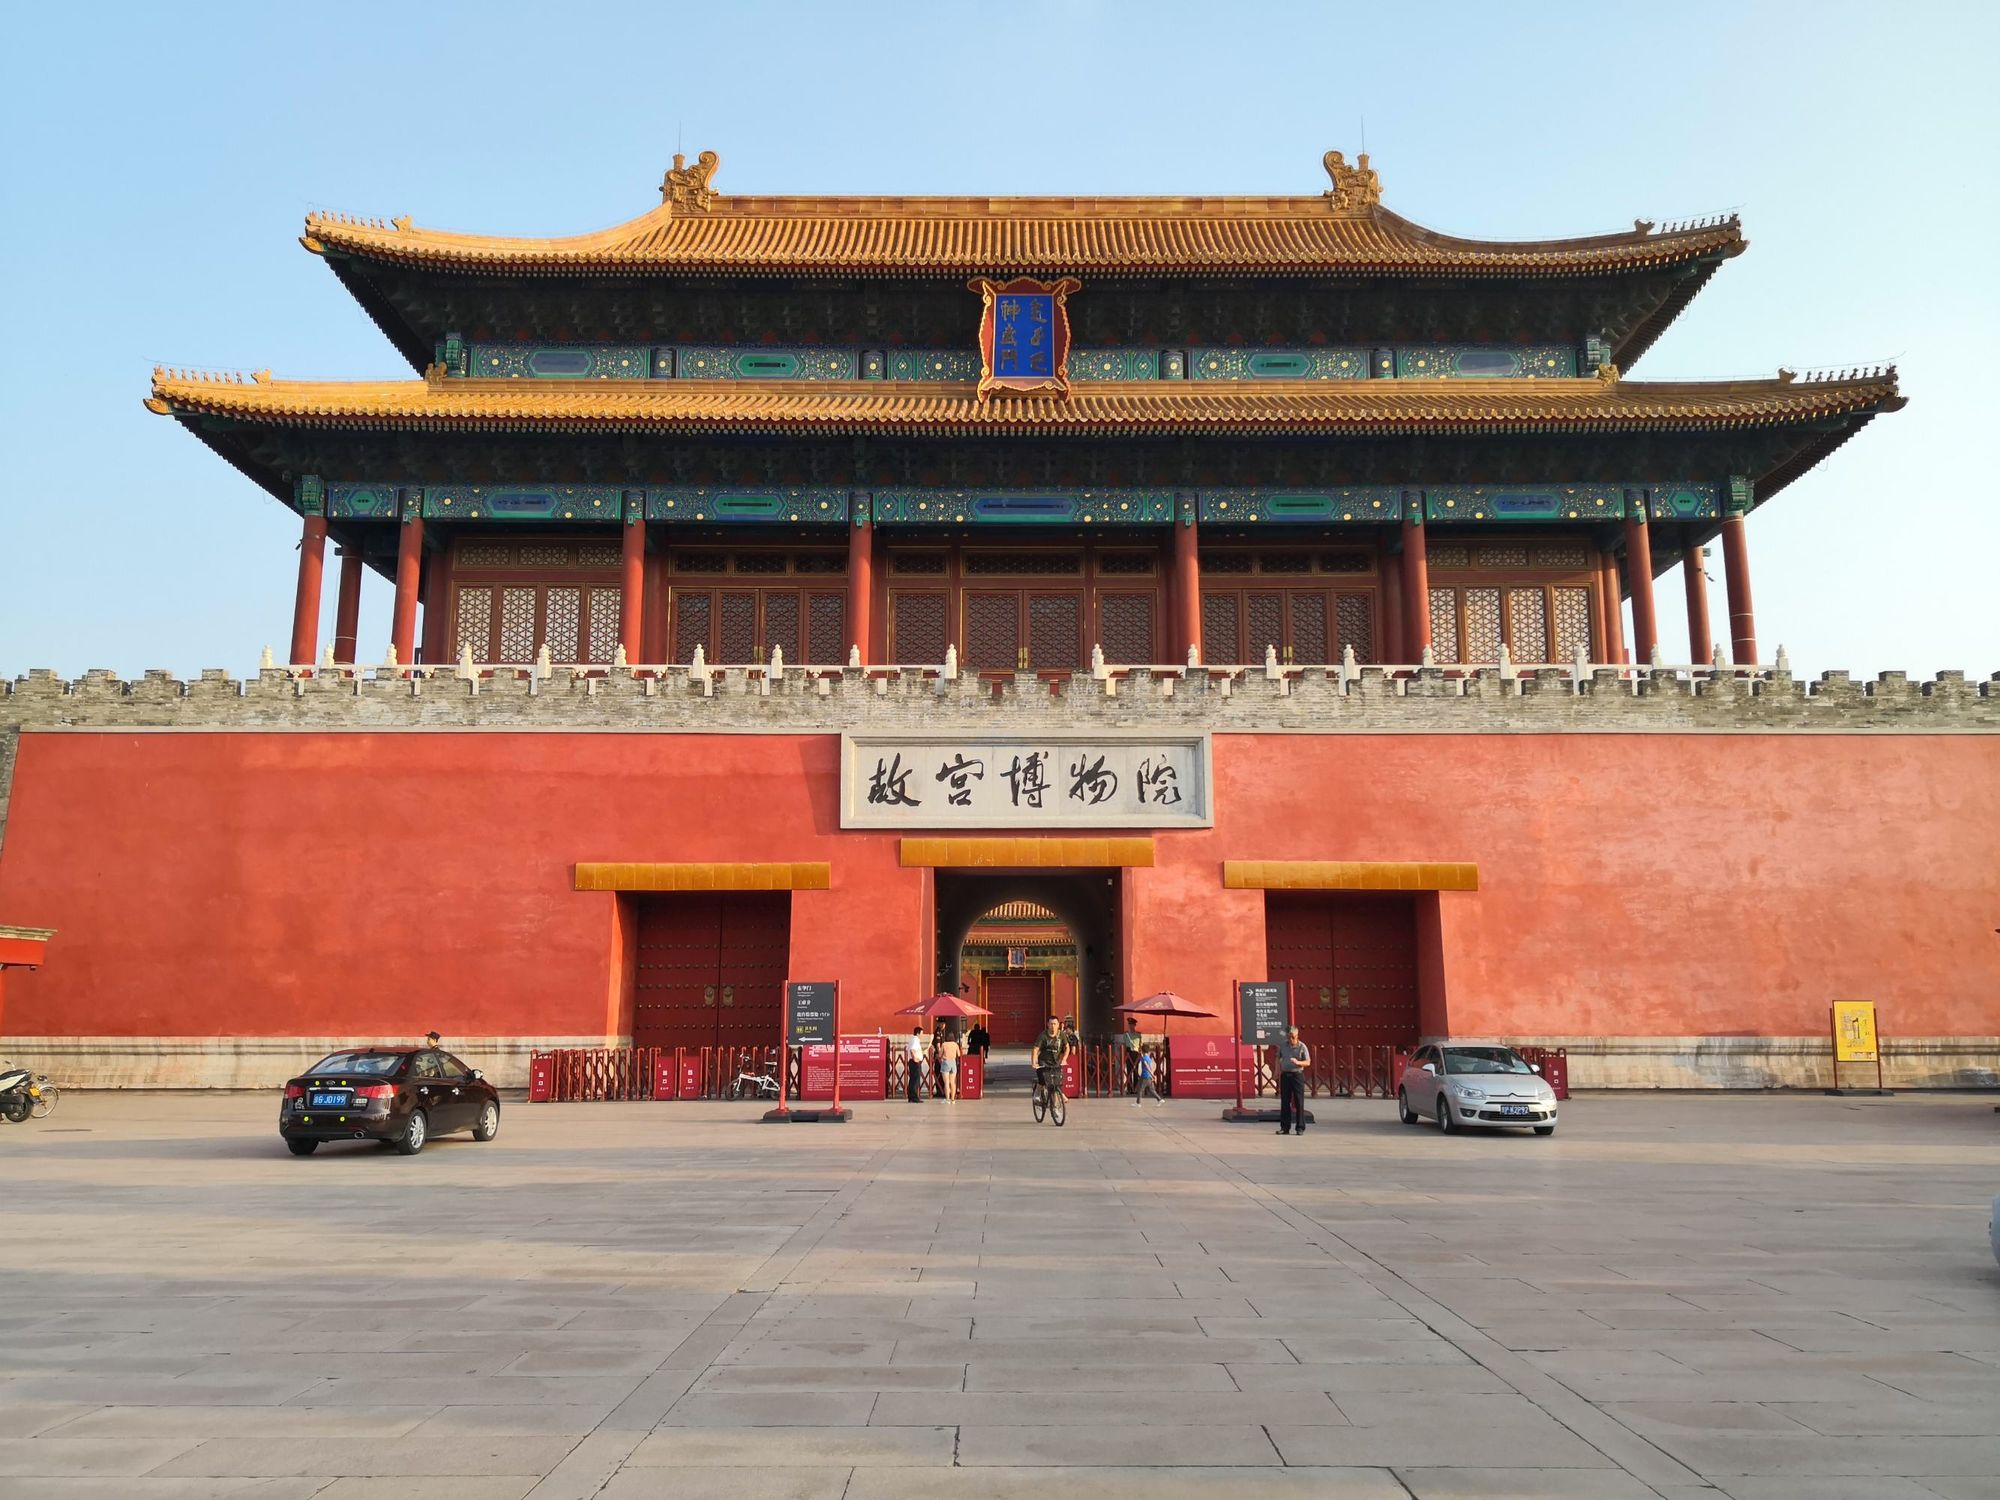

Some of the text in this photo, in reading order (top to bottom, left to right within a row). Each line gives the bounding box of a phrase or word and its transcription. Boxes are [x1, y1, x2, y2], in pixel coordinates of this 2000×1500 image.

[867, 751, 1182, 809] 故宫博物院
